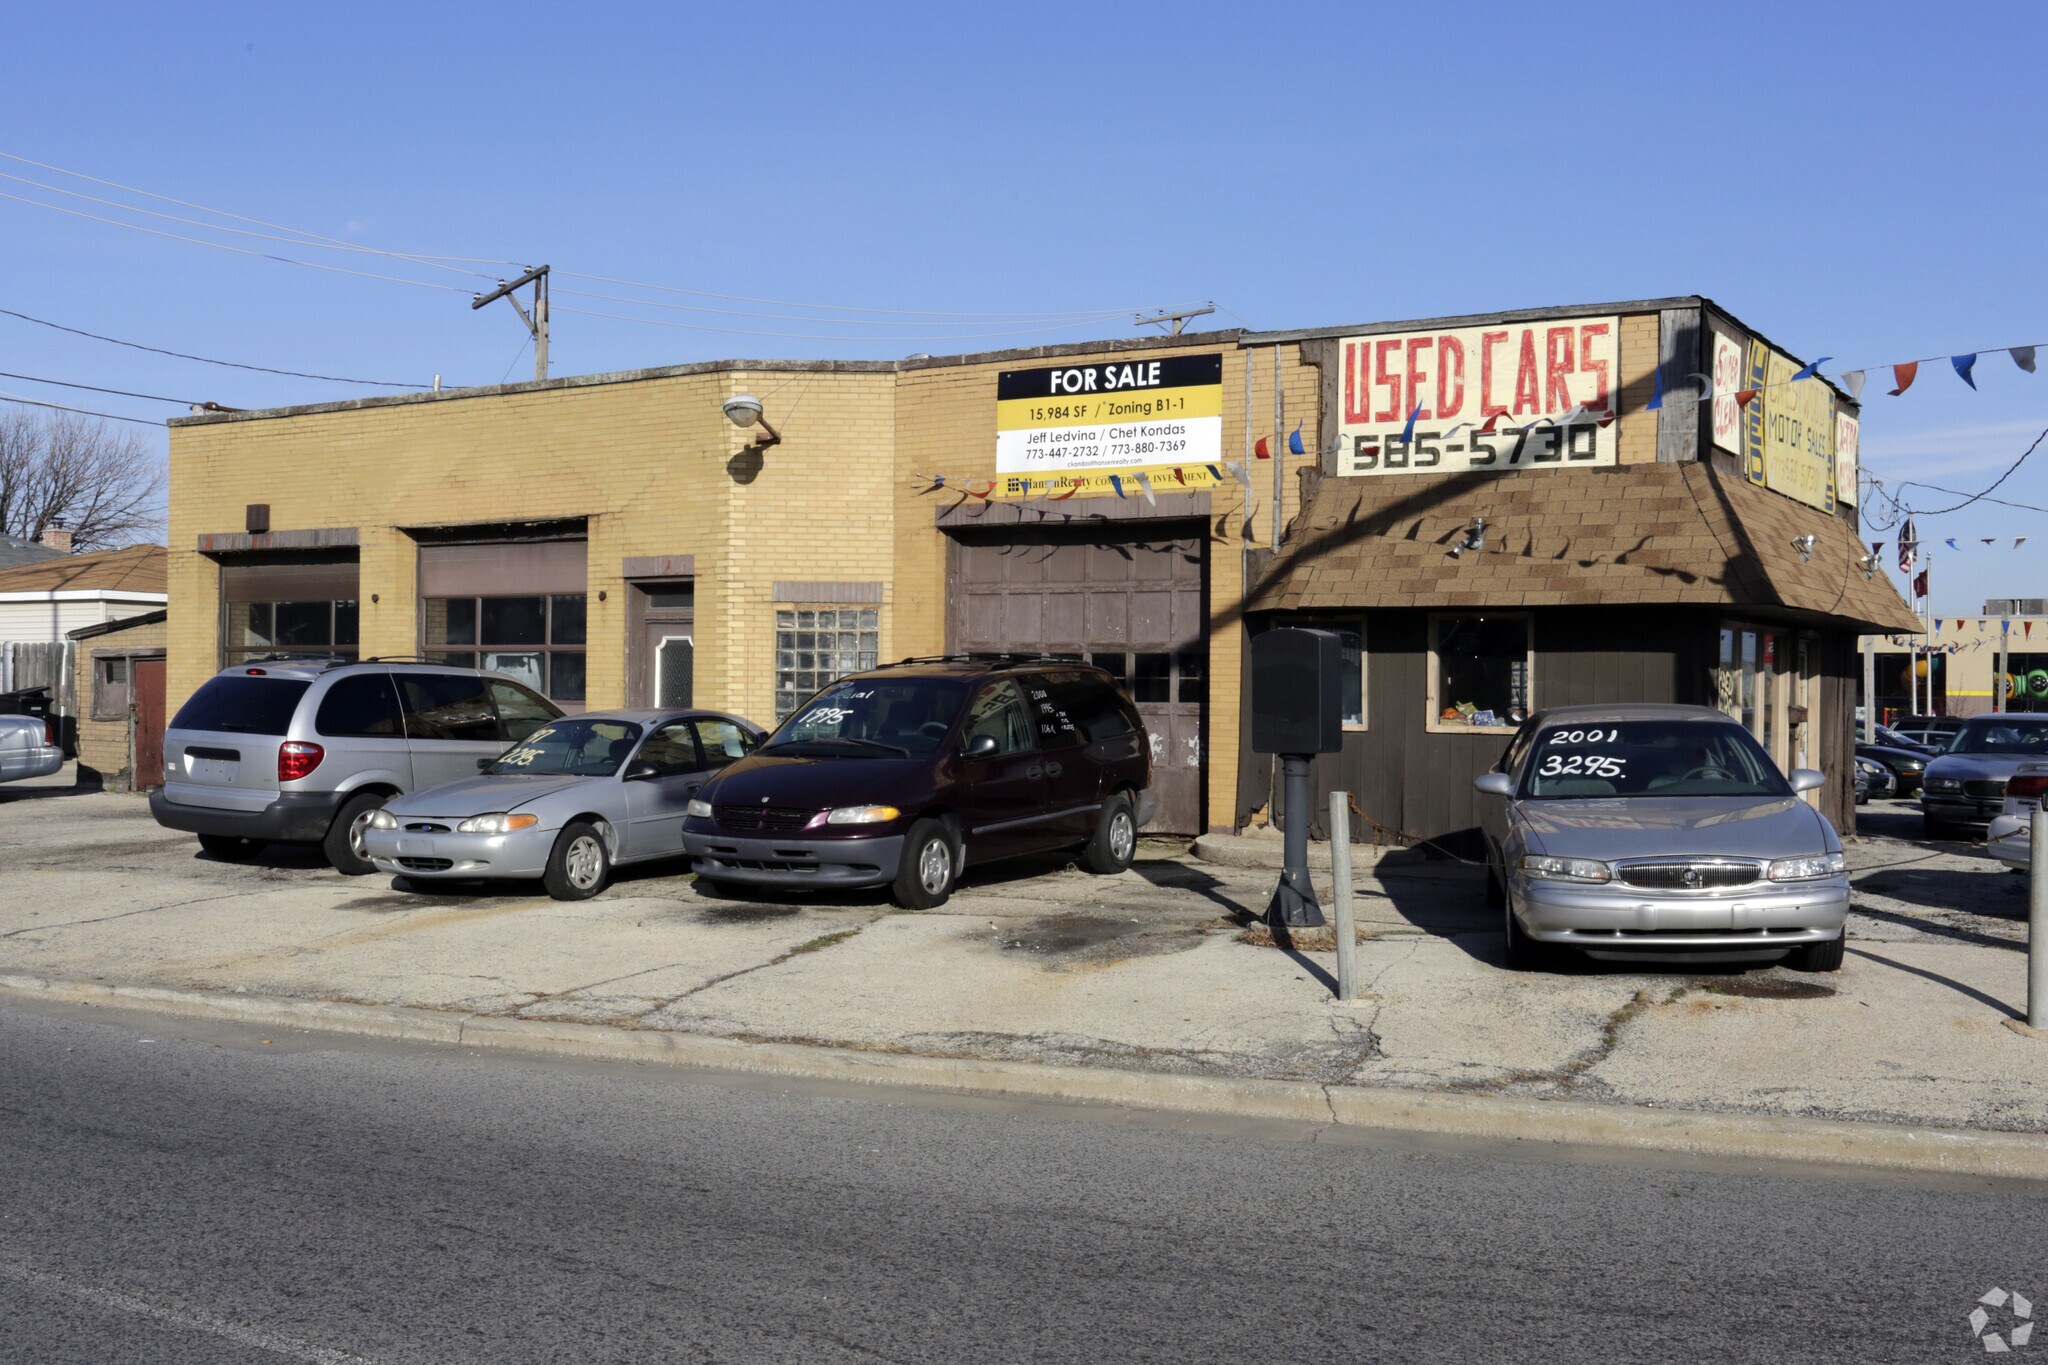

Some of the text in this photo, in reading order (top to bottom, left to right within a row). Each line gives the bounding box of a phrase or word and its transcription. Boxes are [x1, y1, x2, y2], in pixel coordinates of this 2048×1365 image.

[1051, 362, 1160, 394] FOR SALE
[1345, 323, 1609, 424] USED CARS
[1030, 406, 1070, 421] 15,984
[1074, 405, 1087, 418] SF
[1109, 401, 1151, 415] Zoning
[1156, 397, 1184, 411] B1-1
[1027, 431, 1047, 444] Jeff
[1050, 430, 1096, 443] Ledvina
[1109, 426, 1137, 439] Chet
[1141, 424, 1186, 437] Kondas
[1354, 424, 1597, 470] 585-5730
[1769, 410, 1825, 459] MOTOR SALES
[1026, 445, 1099, 459] 773-447-2732
[1111, 439, 1186, 455] 773-880-7369
[1549, 729, 1618, 745] 2001
